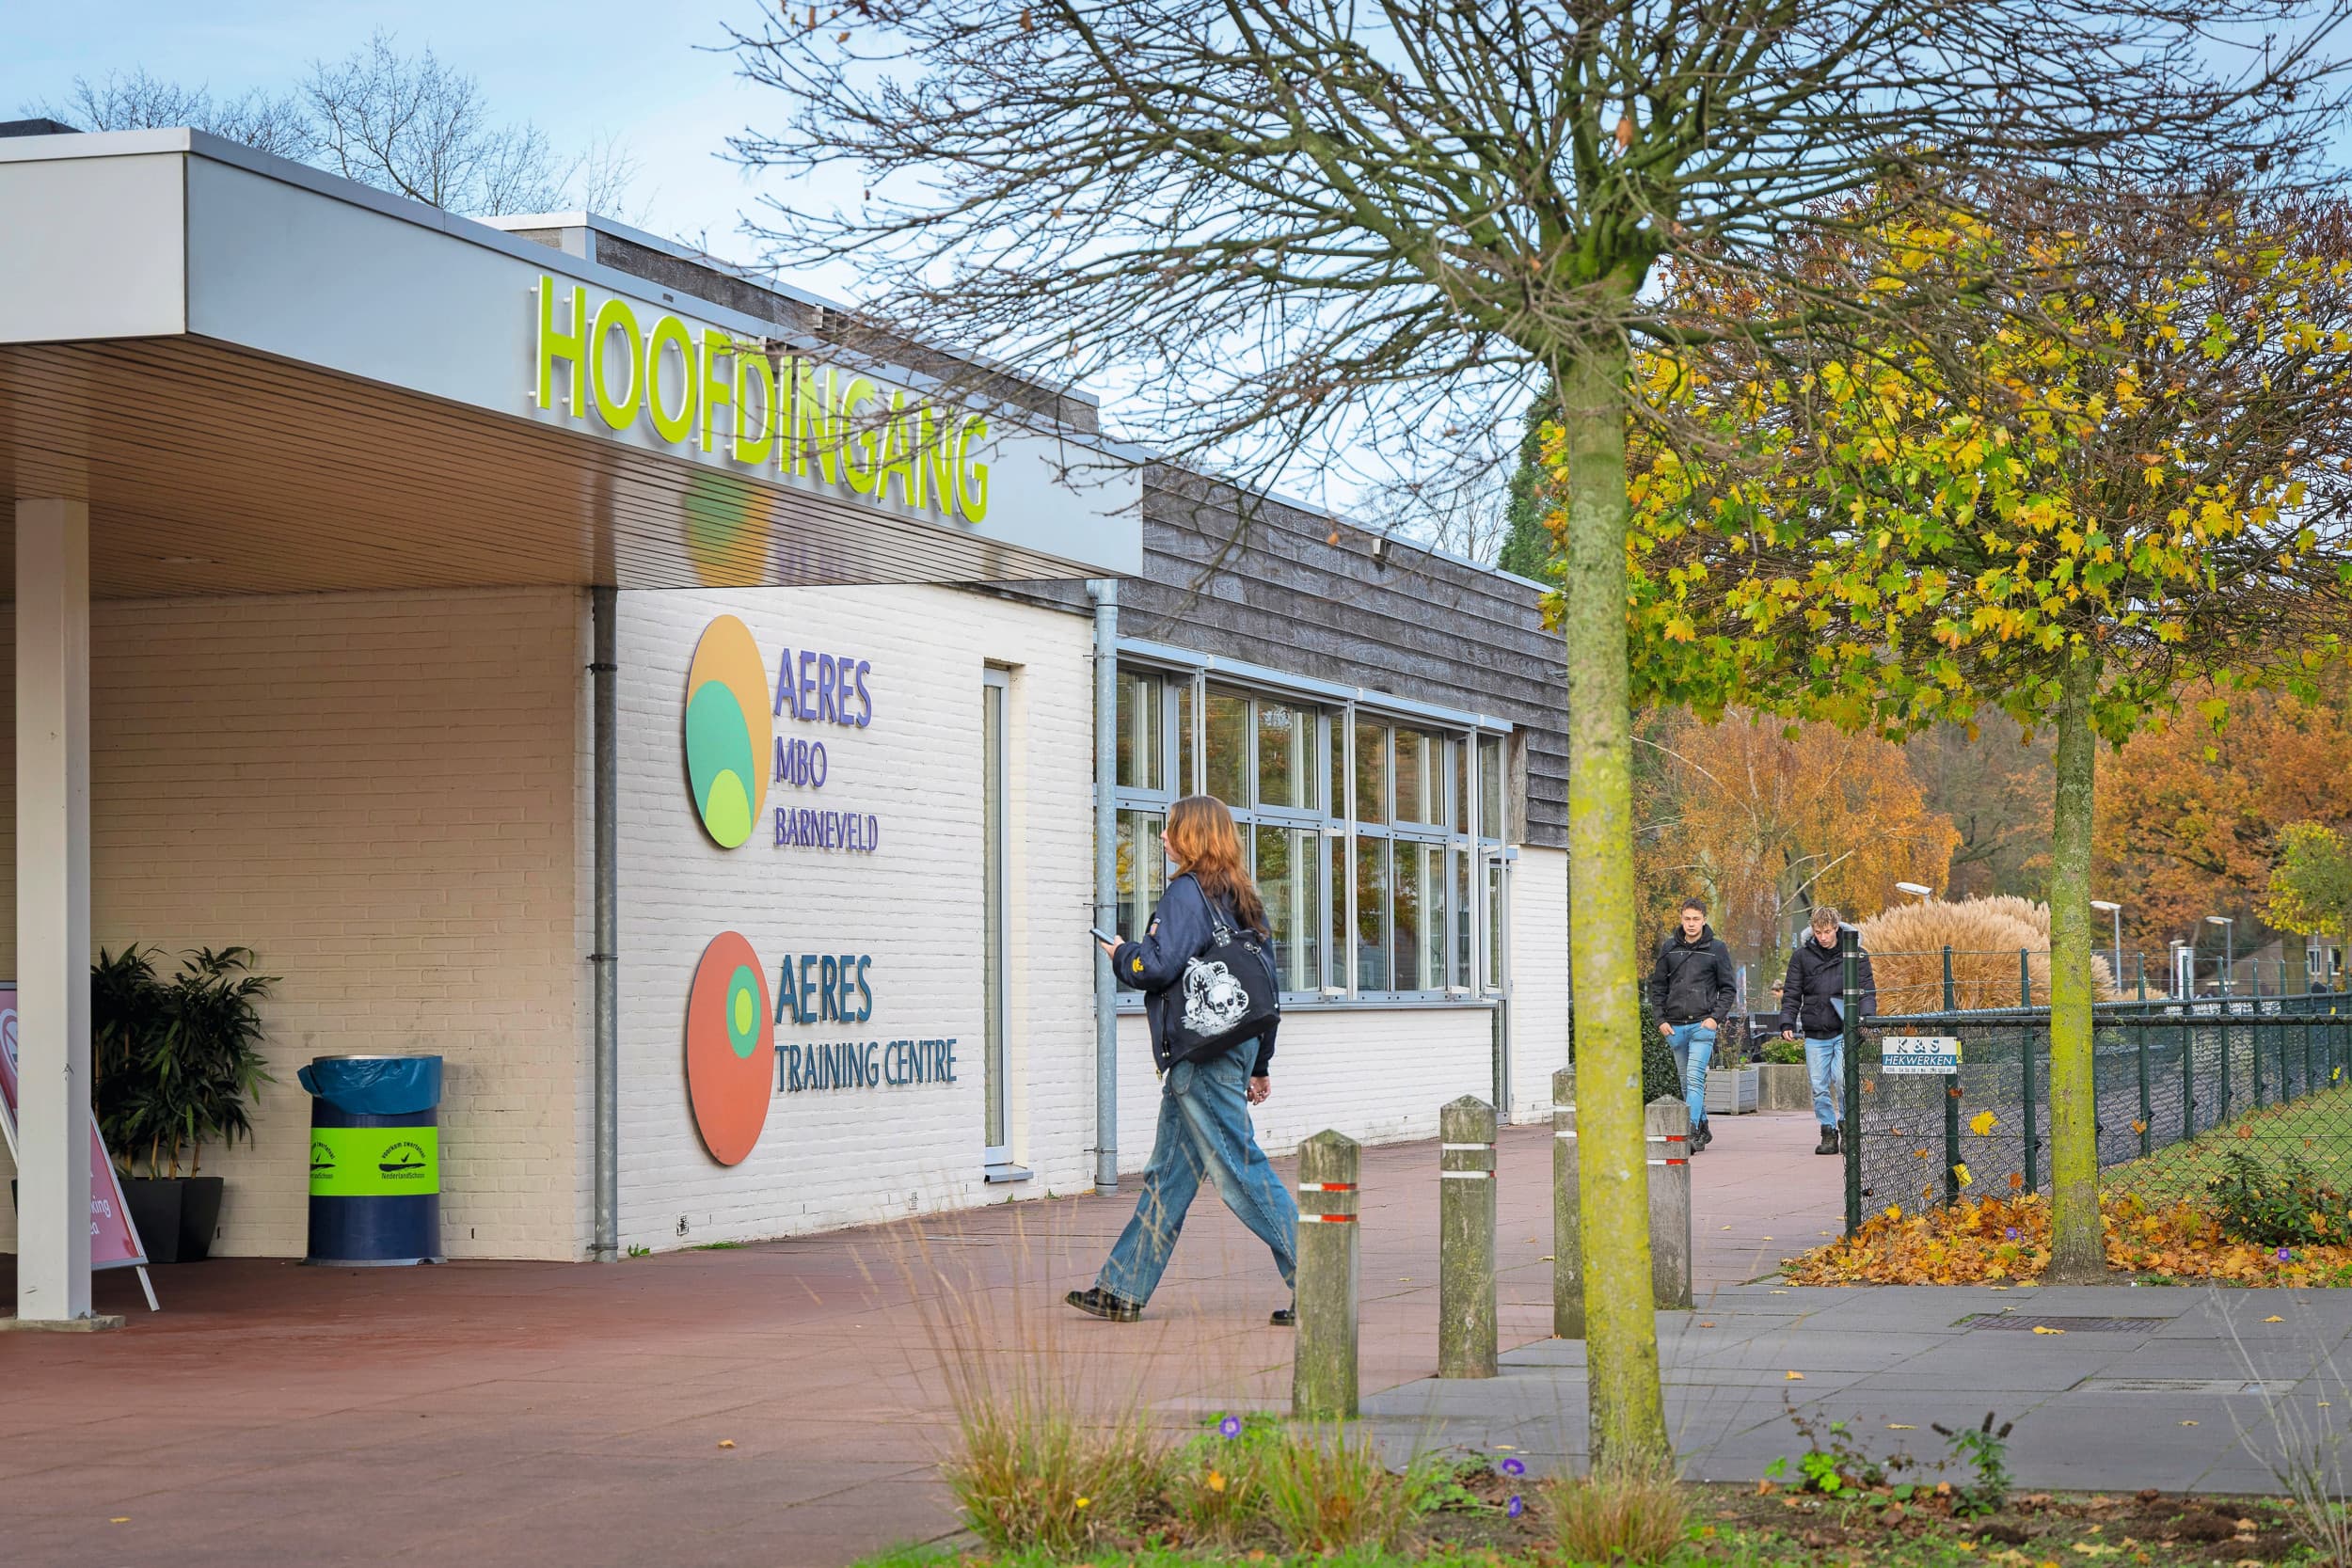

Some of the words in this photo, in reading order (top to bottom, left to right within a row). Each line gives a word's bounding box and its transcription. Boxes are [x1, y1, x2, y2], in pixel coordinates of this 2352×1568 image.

[536, 275, 989, 523] HOOFDINGANG
[774, 648, 872, 727] AERES
[776, 736, 828, 787] MBO
[775, 807, 879, 851] BARNEVELD
[774, 955, 872, 1024] AERES
[775, 1041, 880, 1091] TRAINING
[884, 1038, 957, 1085] CENTRE
[1884, 1055, 1953, 1066] HEKWERKEN
[1897, 1037, 1908, 1053] K
[1914, 1037, 1926, 1053] &
[1931, 1037, 1940, 1053] S
